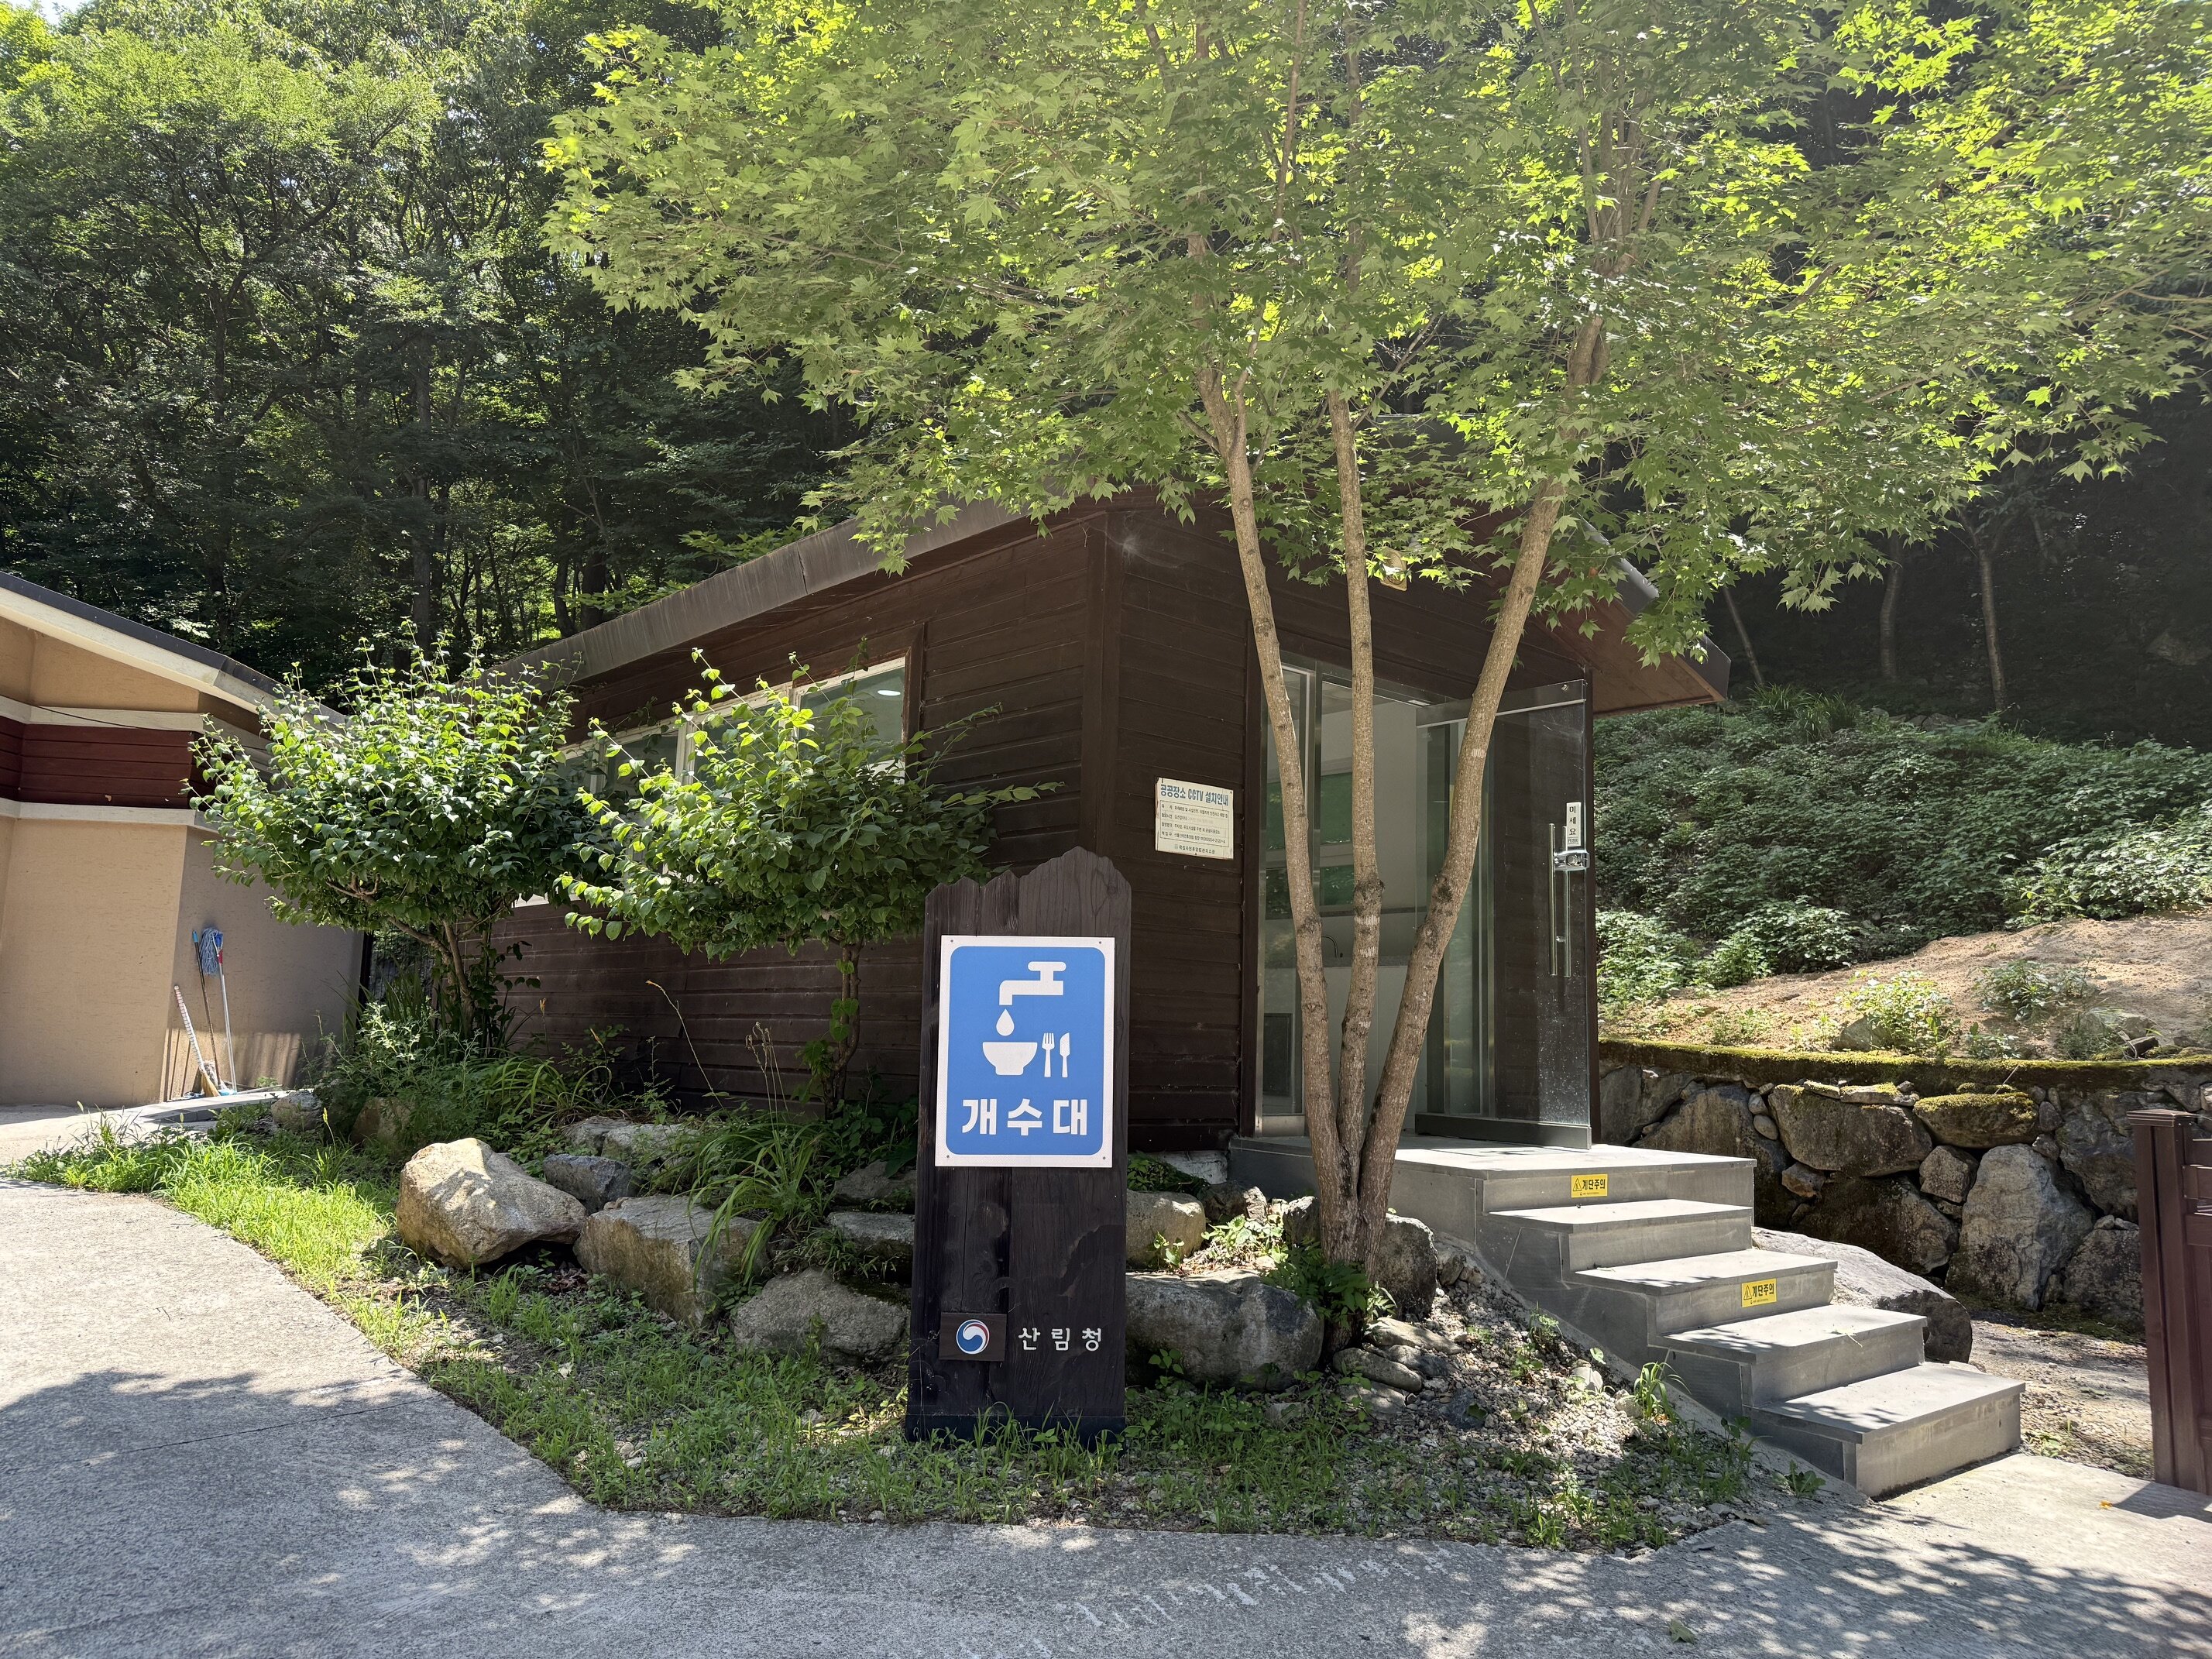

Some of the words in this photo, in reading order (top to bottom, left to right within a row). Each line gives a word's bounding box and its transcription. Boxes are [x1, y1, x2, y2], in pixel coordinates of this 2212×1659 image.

[1160, 784, 1186, 799] 공공장소
[1187, 788, 1204, 802] CCTV
[1205, 792, 1229, 806] 설치안내
[962, 1098, 1087, 1136] 개수대
[1582, 1179, 1606, 1190] 계단주의
[1752, 1283, 1774, 1297] 계단주의
[1018, 1327, 1102, 1352] 산림청
